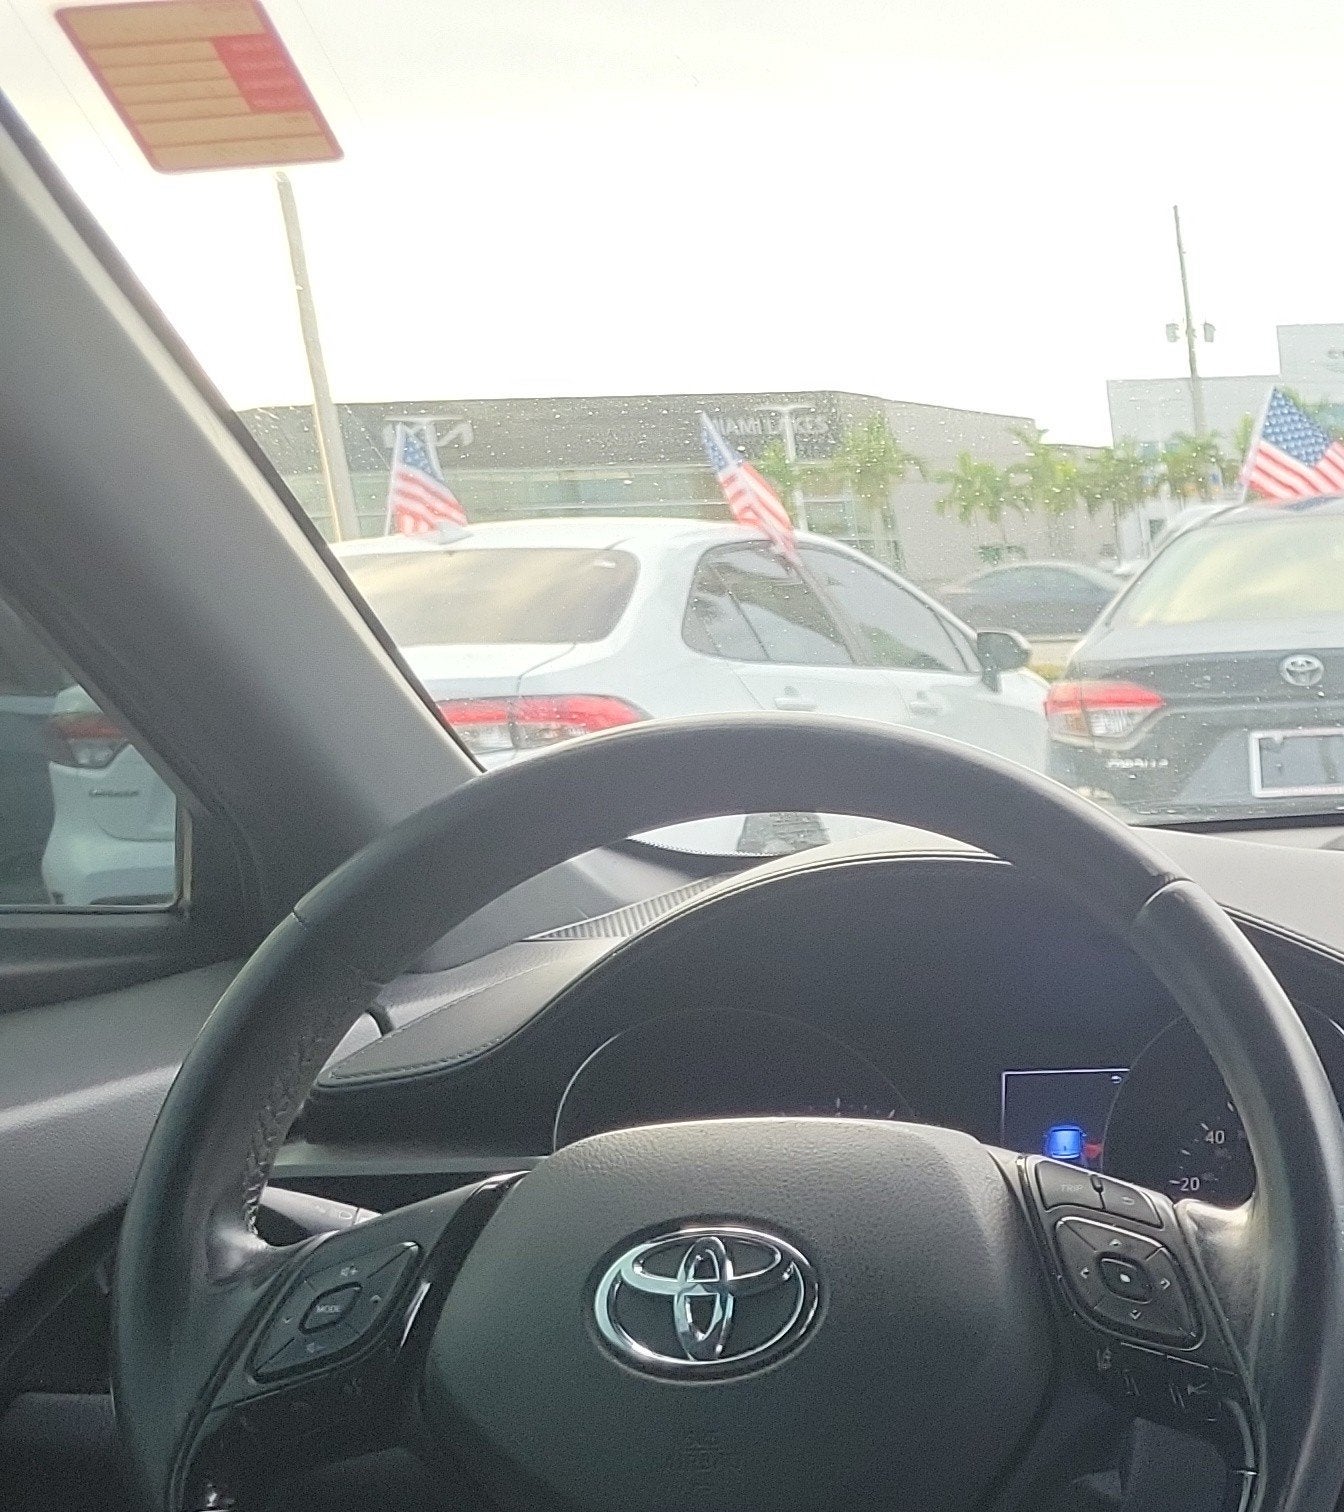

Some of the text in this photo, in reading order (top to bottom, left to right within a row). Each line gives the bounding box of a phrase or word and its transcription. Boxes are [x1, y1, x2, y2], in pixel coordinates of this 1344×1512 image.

[1205, 1130, 1225, 1144] 40
[1060, 1184, 1084, 1192] TRIP
[1180, 1177, 1200, 1192] 20
[316, 1305, 342, 1313] MODE
